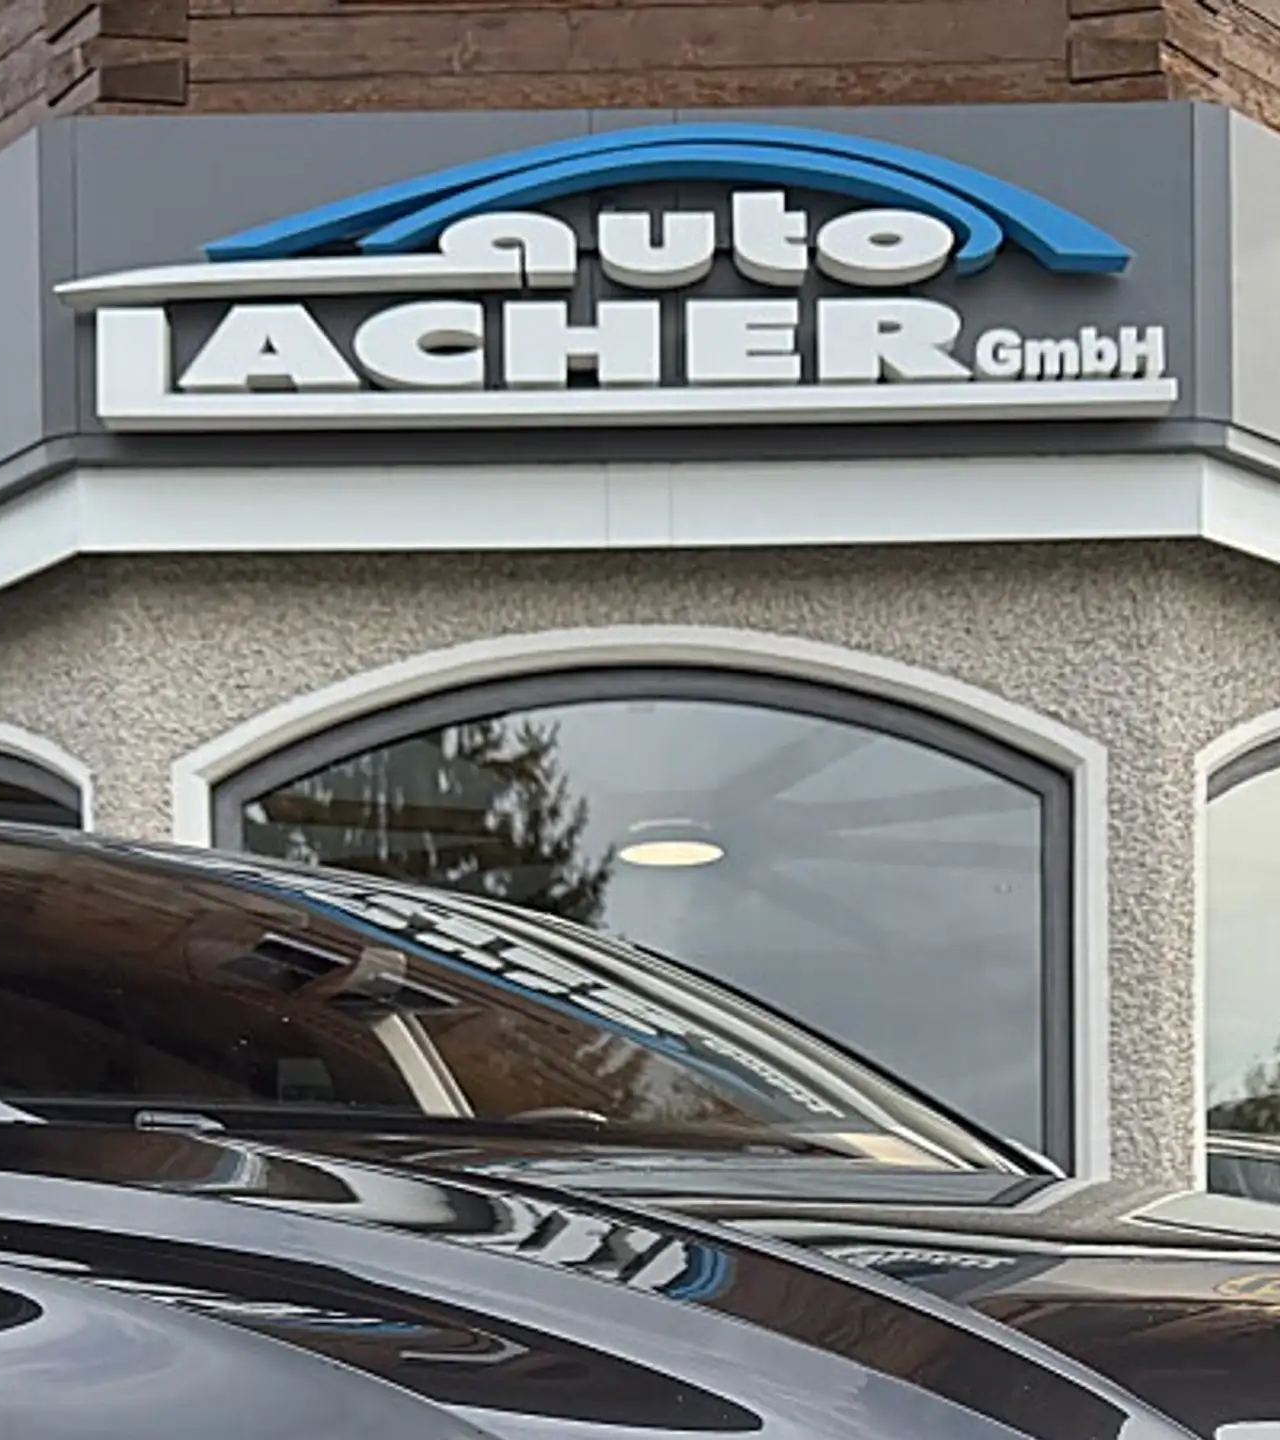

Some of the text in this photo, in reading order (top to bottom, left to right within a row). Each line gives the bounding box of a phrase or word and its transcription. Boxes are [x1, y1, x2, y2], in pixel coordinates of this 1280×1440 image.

[439, 191, 956, 286] auto
[97, 298, 1165, 418] LACHER GmbH
